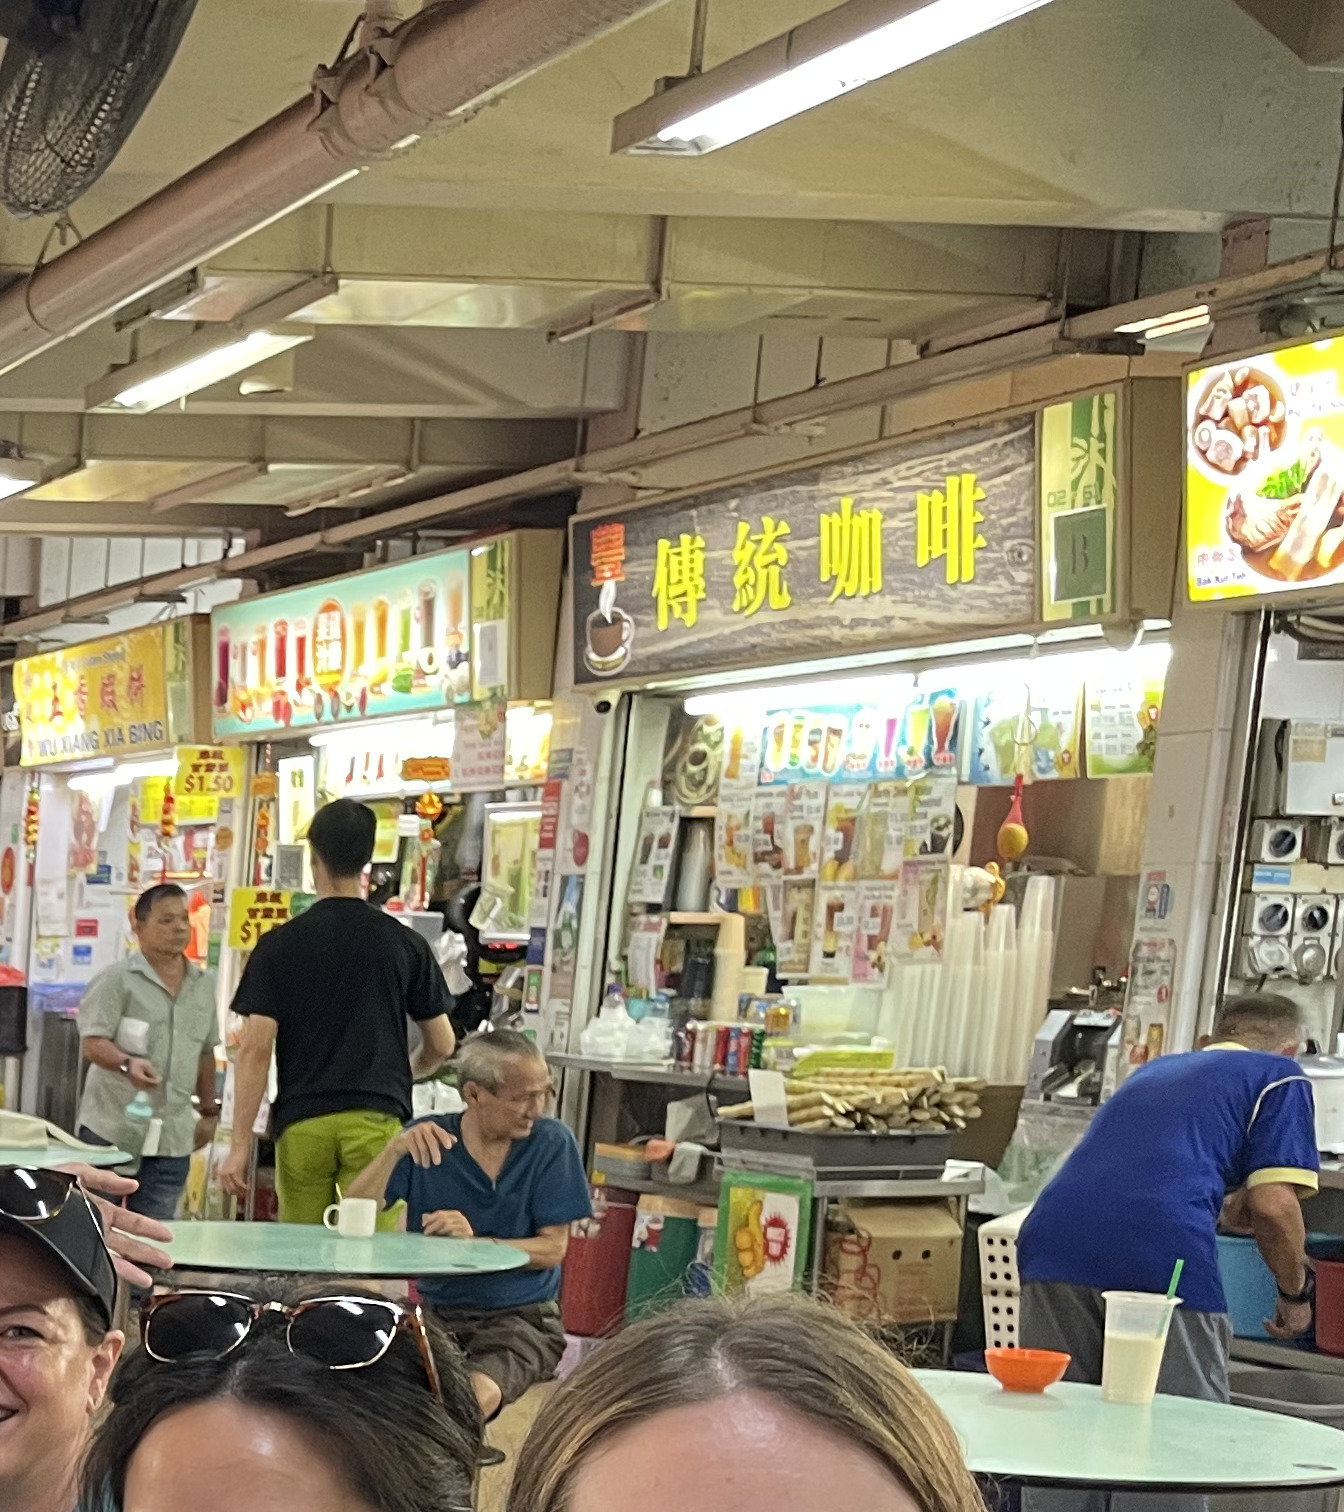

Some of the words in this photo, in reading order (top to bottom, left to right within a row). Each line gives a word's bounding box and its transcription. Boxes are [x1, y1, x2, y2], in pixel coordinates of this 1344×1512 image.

[652, 473, 988, 631] 傳統咖啡
[61, 730, 100, 755] XIANG
[103, 727, 126, 746] XIA
[129, 720, 163, 745] BING
[184, 775, 234, 793] $1.50
